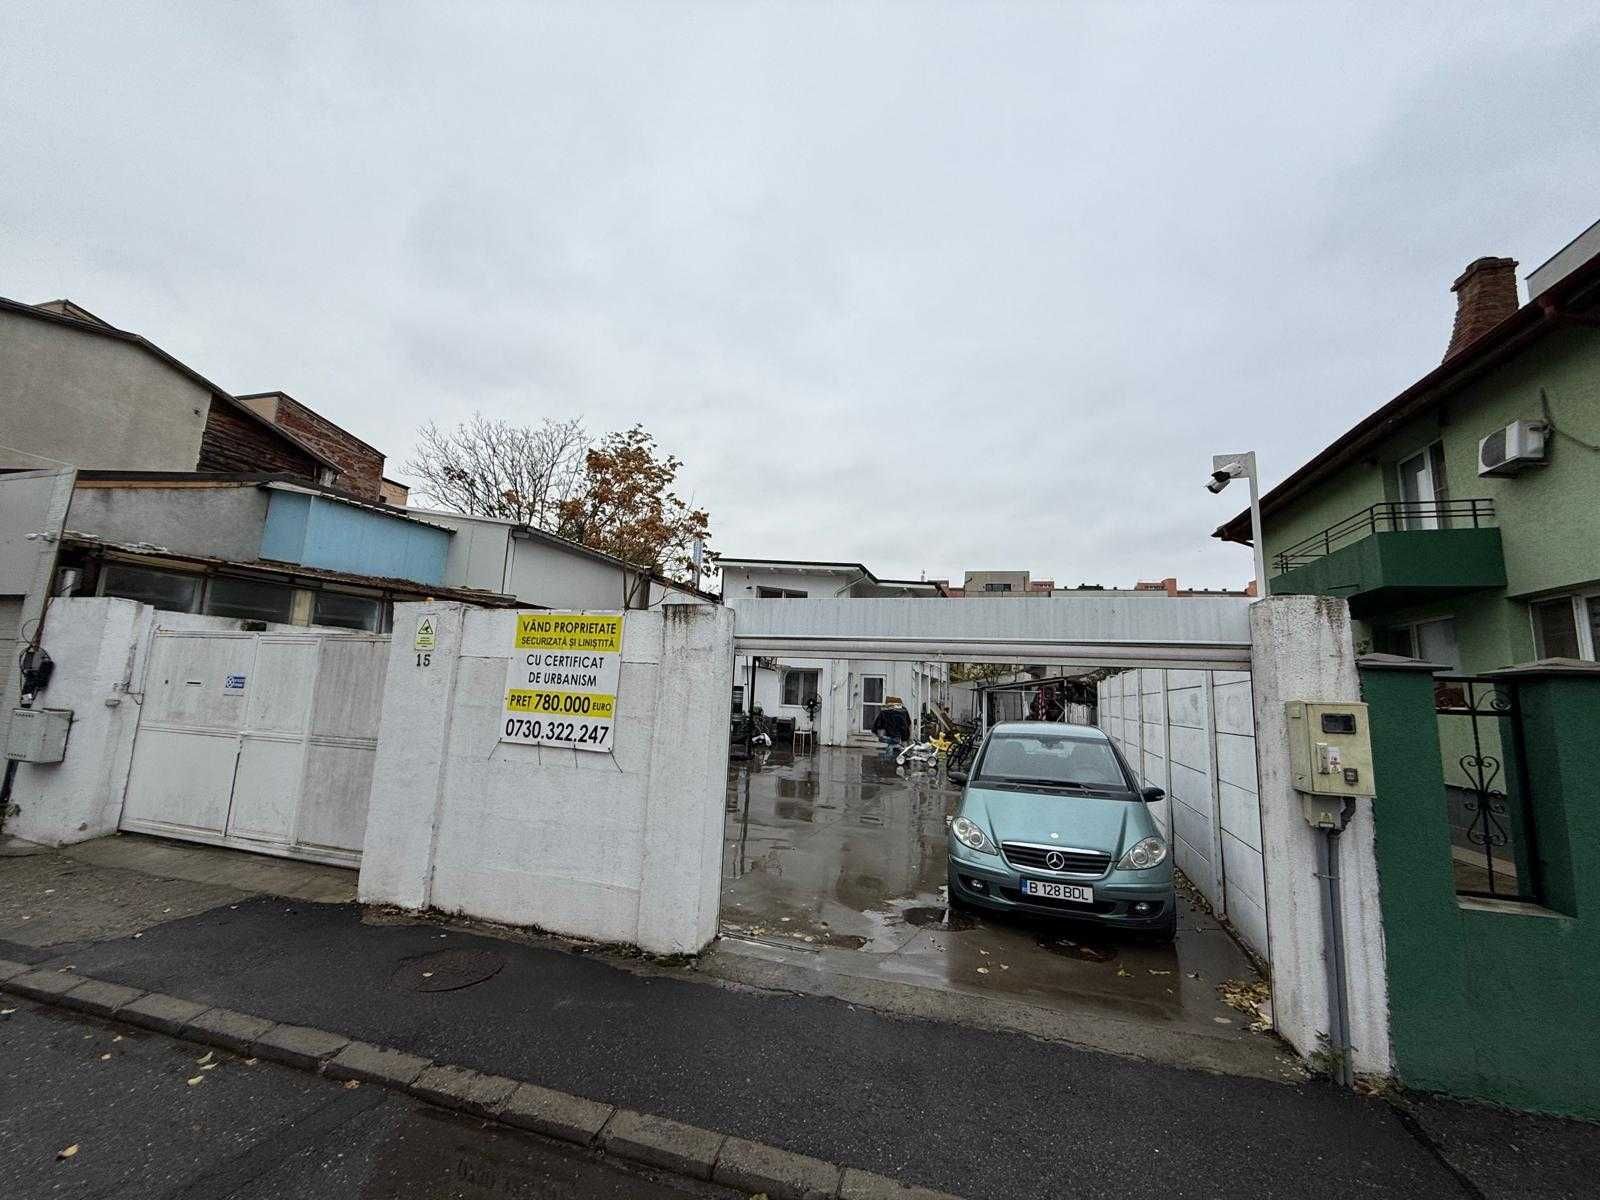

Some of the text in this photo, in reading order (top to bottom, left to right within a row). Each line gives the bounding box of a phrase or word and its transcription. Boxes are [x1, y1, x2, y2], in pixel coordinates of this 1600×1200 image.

[523, 619, 616, 634] VÂND PROPRIETATE
[416, 653, 431, 667] 15
[526, 654, 604, 669] CU CERTIFICAT
[528, 672, 597, 686] DE URBANISM
[509, 694, 612, 713] PRET 780.000 EURO
[505, 718, 609, 744] 0730.322.247
[1029, 882, 1089, 901] B 128 BDL
